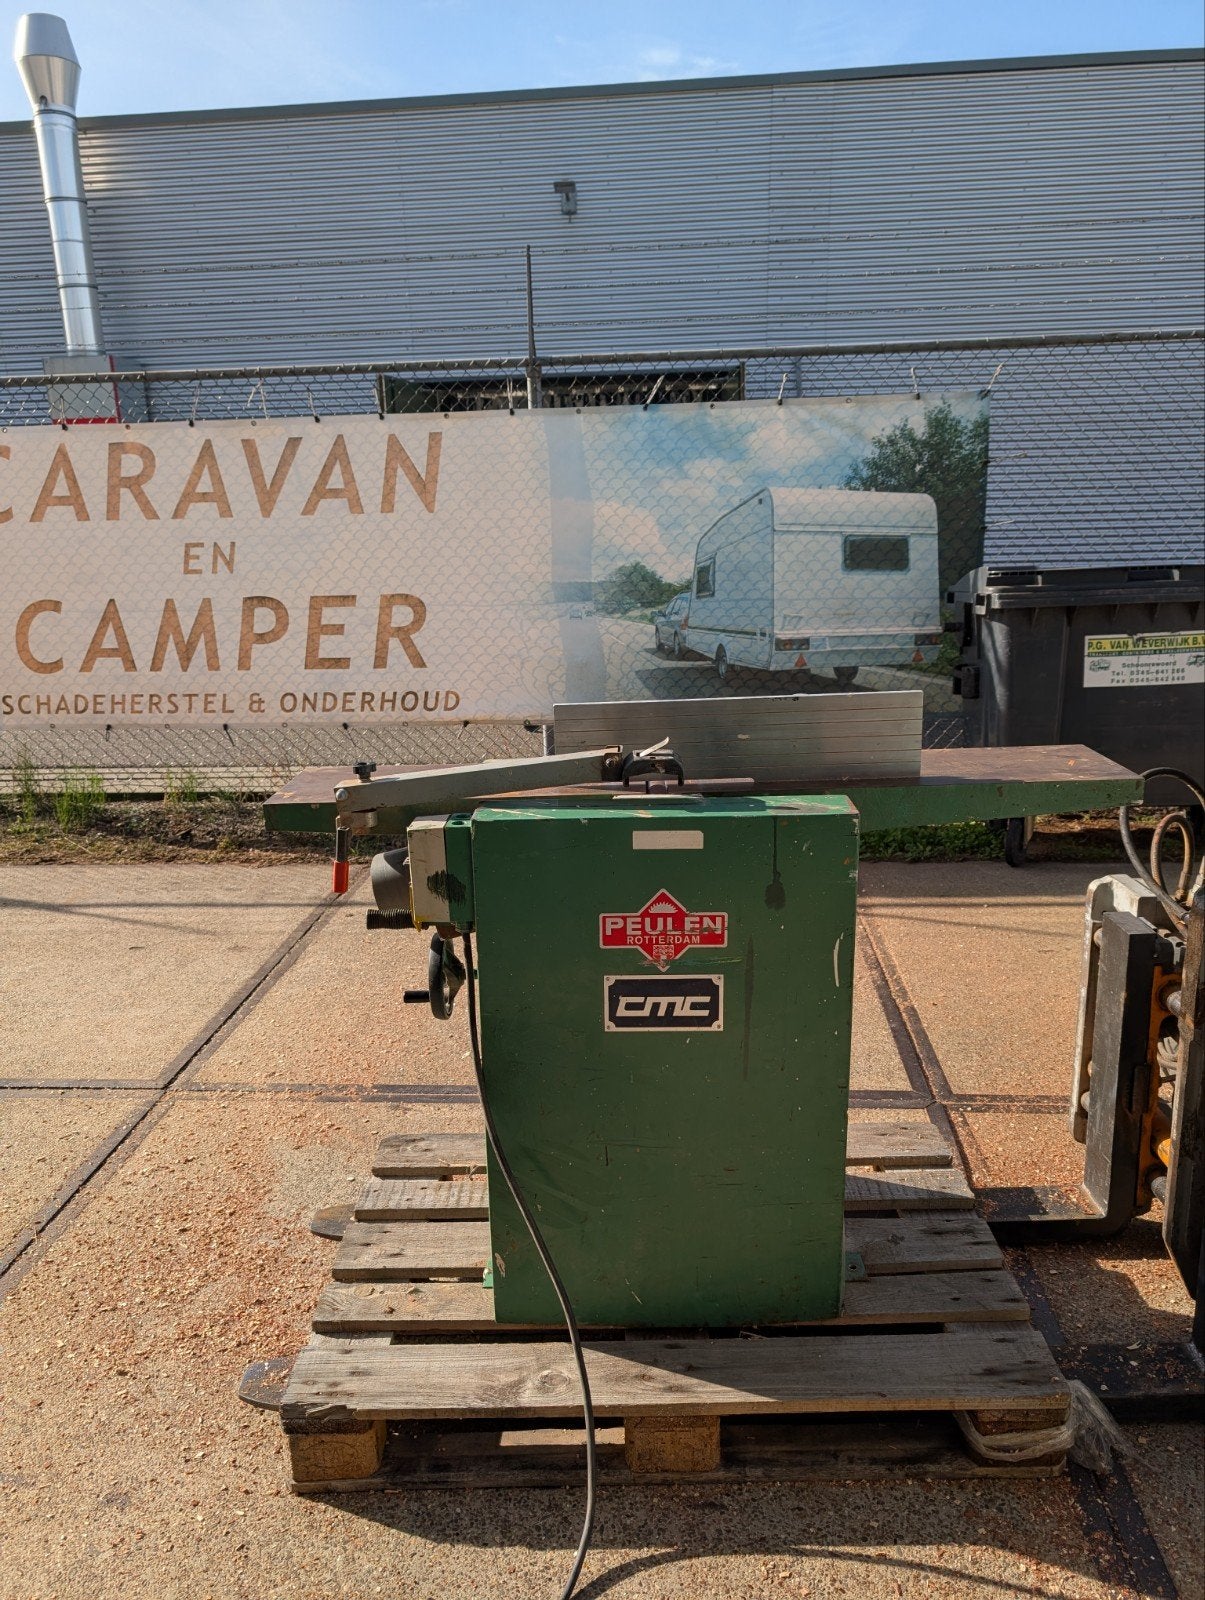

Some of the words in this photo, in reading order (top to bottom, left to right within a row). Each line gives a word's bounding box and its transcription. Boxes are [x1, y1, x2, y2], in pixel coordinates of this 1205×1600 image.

[0, 432, 442, 524] ARAVAN
[183, 541, 236, 575] EN
[15, 593, 428, 674] CAMPER
[1088, 641, 1106, 650] P.G.
[1110, 640, 1129, 649] VAN
[1133, 637, 1190, 648] WEVERWIJK
[2, 693, 234, 715] SCHADEHERSTEL
[248, 692, 265, 713] &
[280, 690, 461, 713] ONDERHOUD
[605, 916, 722, 936] PEULEN
[627, 935, 700, 945] ROTTERDAM
